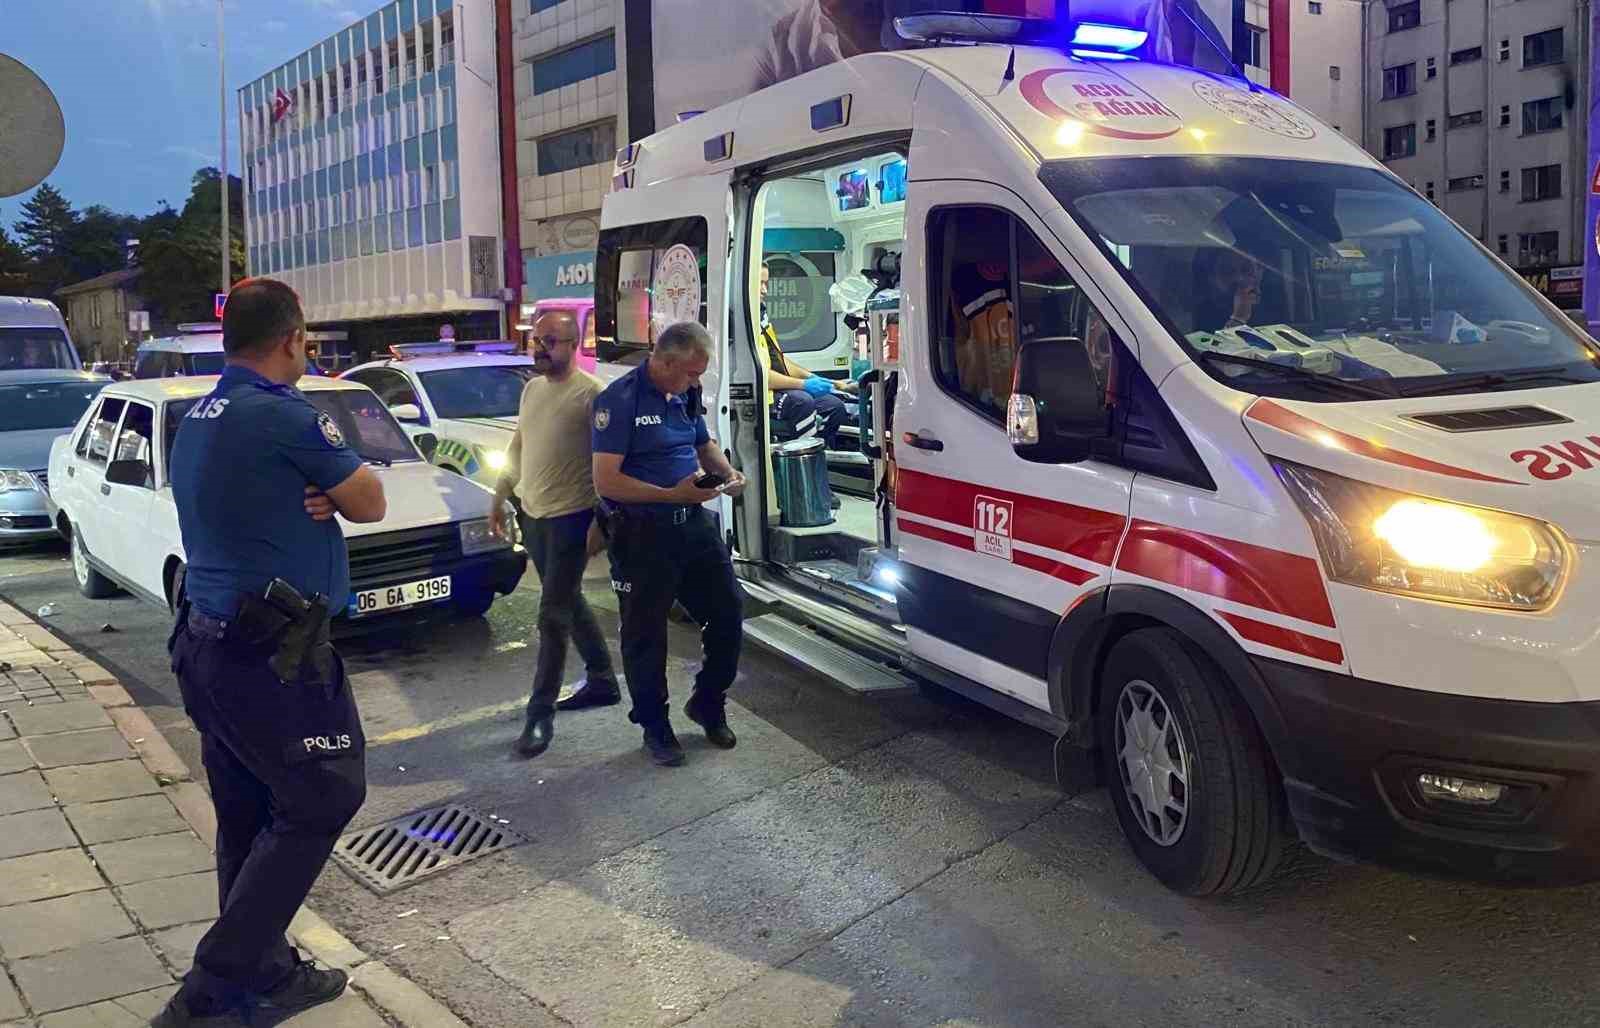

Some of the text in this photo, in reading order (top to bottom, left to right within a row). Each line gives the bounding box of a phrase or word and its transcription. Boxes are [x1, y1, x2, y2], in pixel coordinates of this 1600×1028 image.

[977, 502, 1009, 536] 112
[358, 579, 448, 610] 06 GA 9196
